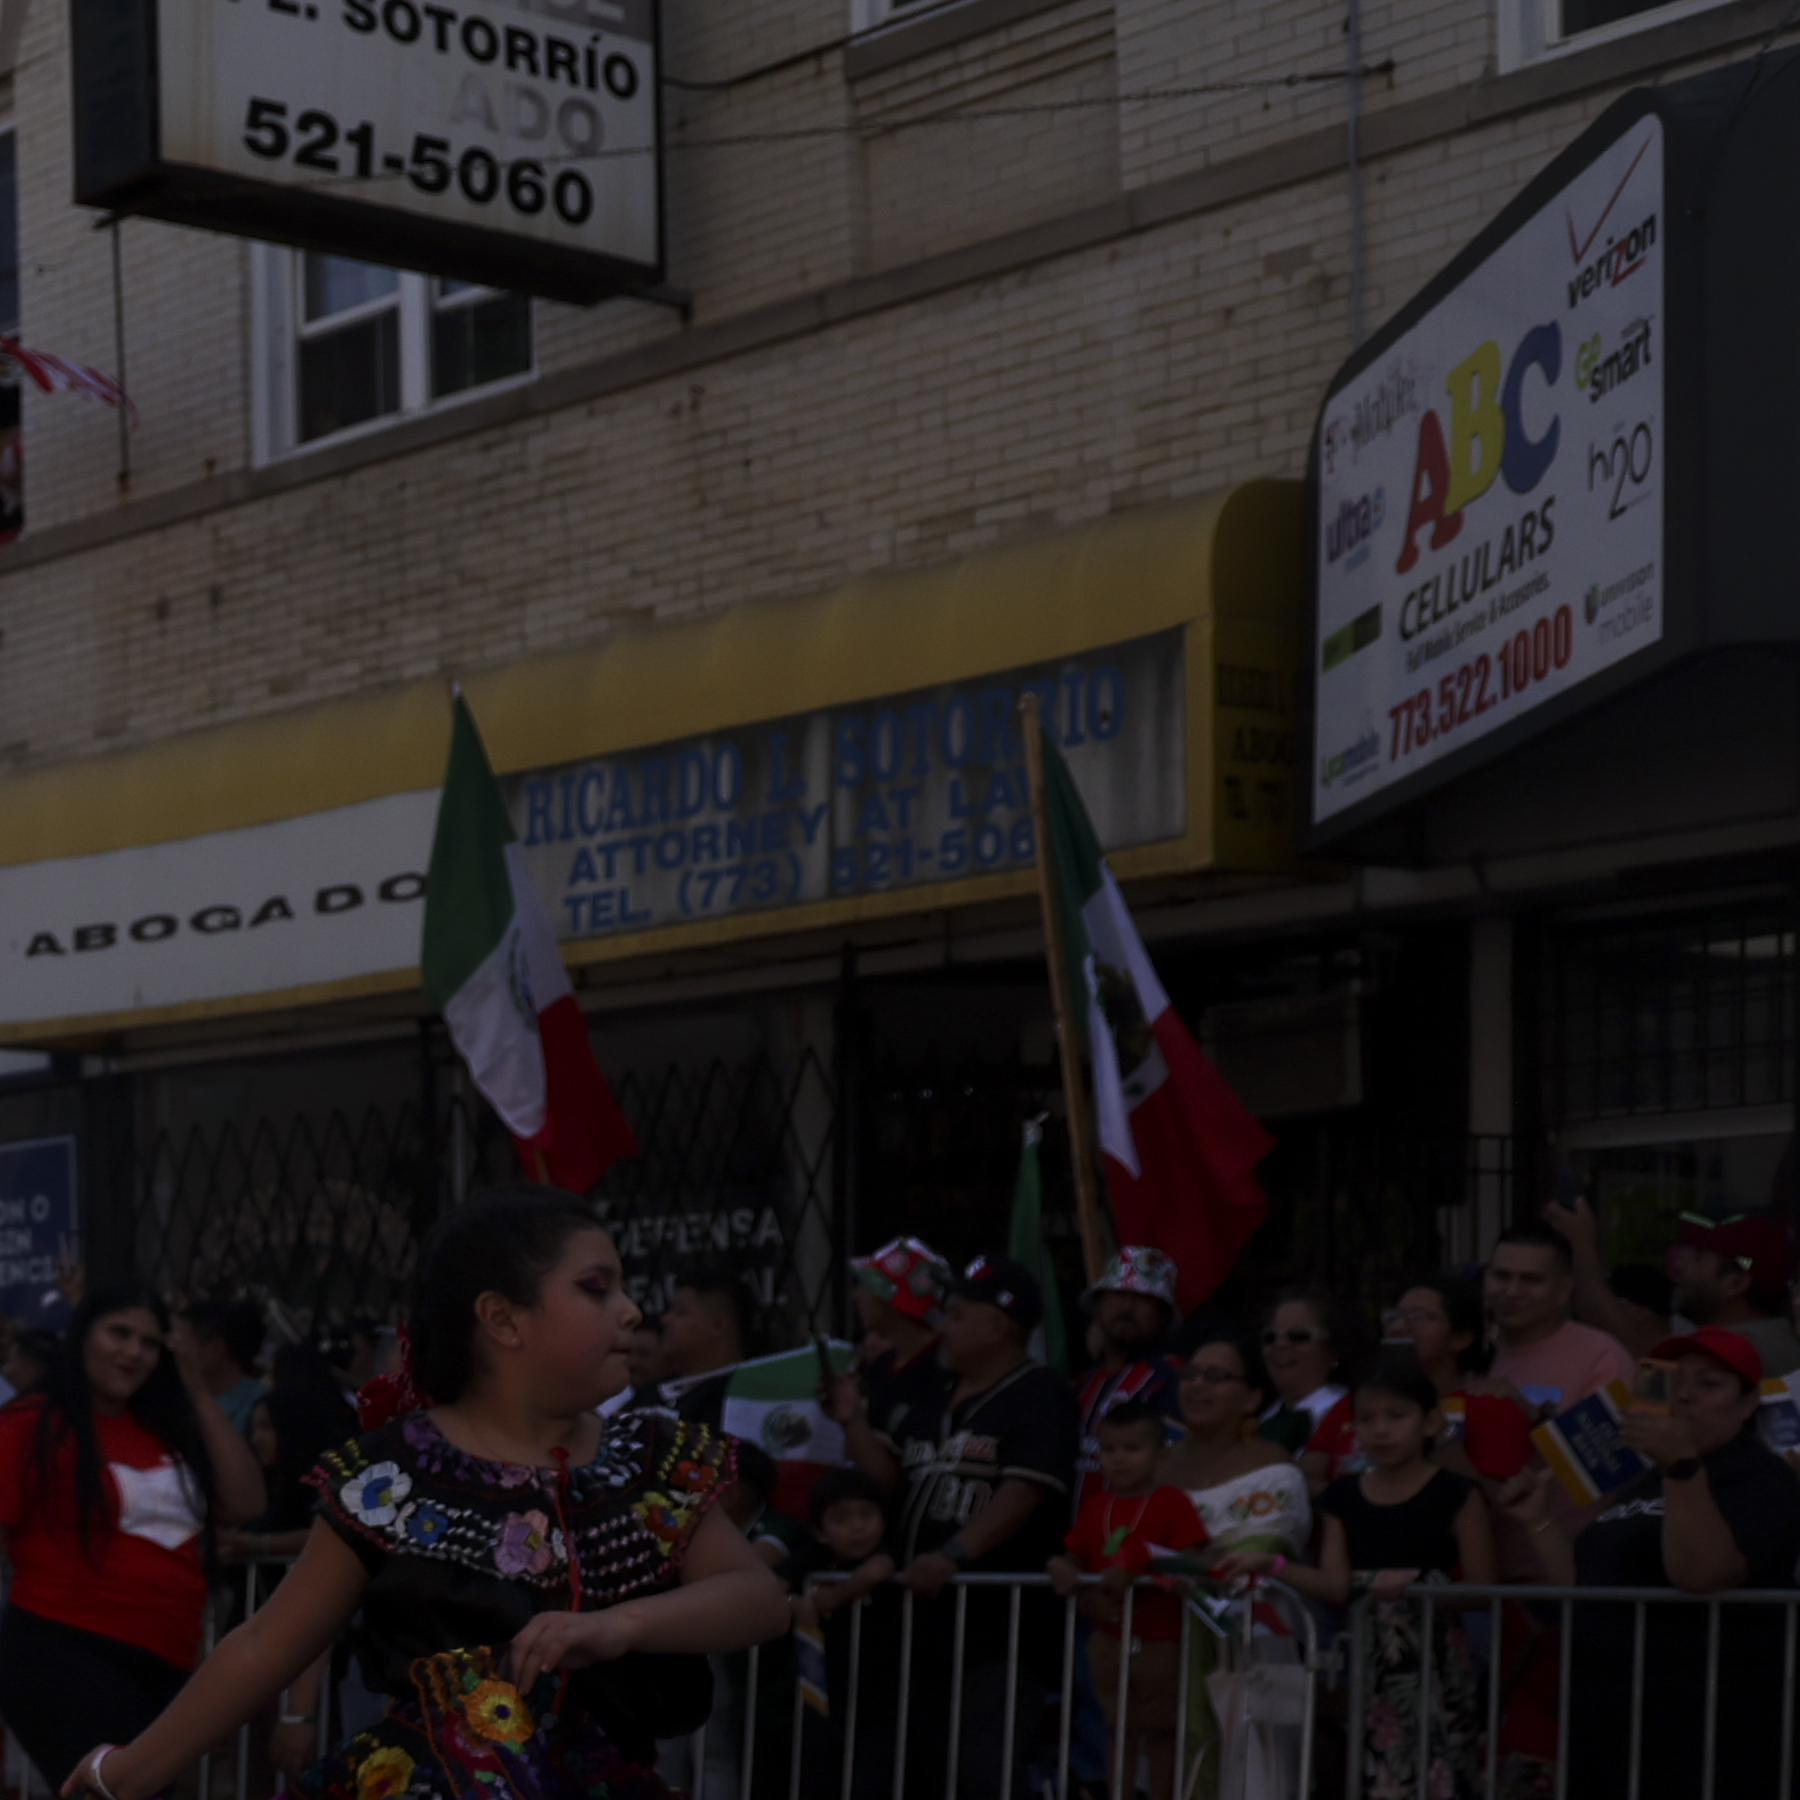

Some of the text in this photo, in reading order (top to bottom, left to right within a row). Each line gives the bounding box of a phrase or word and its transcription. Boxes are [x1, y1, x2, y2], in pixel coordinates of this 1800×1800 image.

[342, 0, 638, 99] SOTORRÍO
[244, 95, 592, 225] 521-5060
[1567, 214, 1657, 309] verizon
[1394, 319, 1563, 575] ABC
[1399, 494, 1556, 641] CELLULARS
[1389, 603, 1573, 763] 773.522.1000
[521, 741, 744, 847] RICARDO
[568, 804, 829, 885] ATTORNEY
[856, 788, 921, 837] AT
[564, 817, 1037, 933] TEL. (773) 521-506
